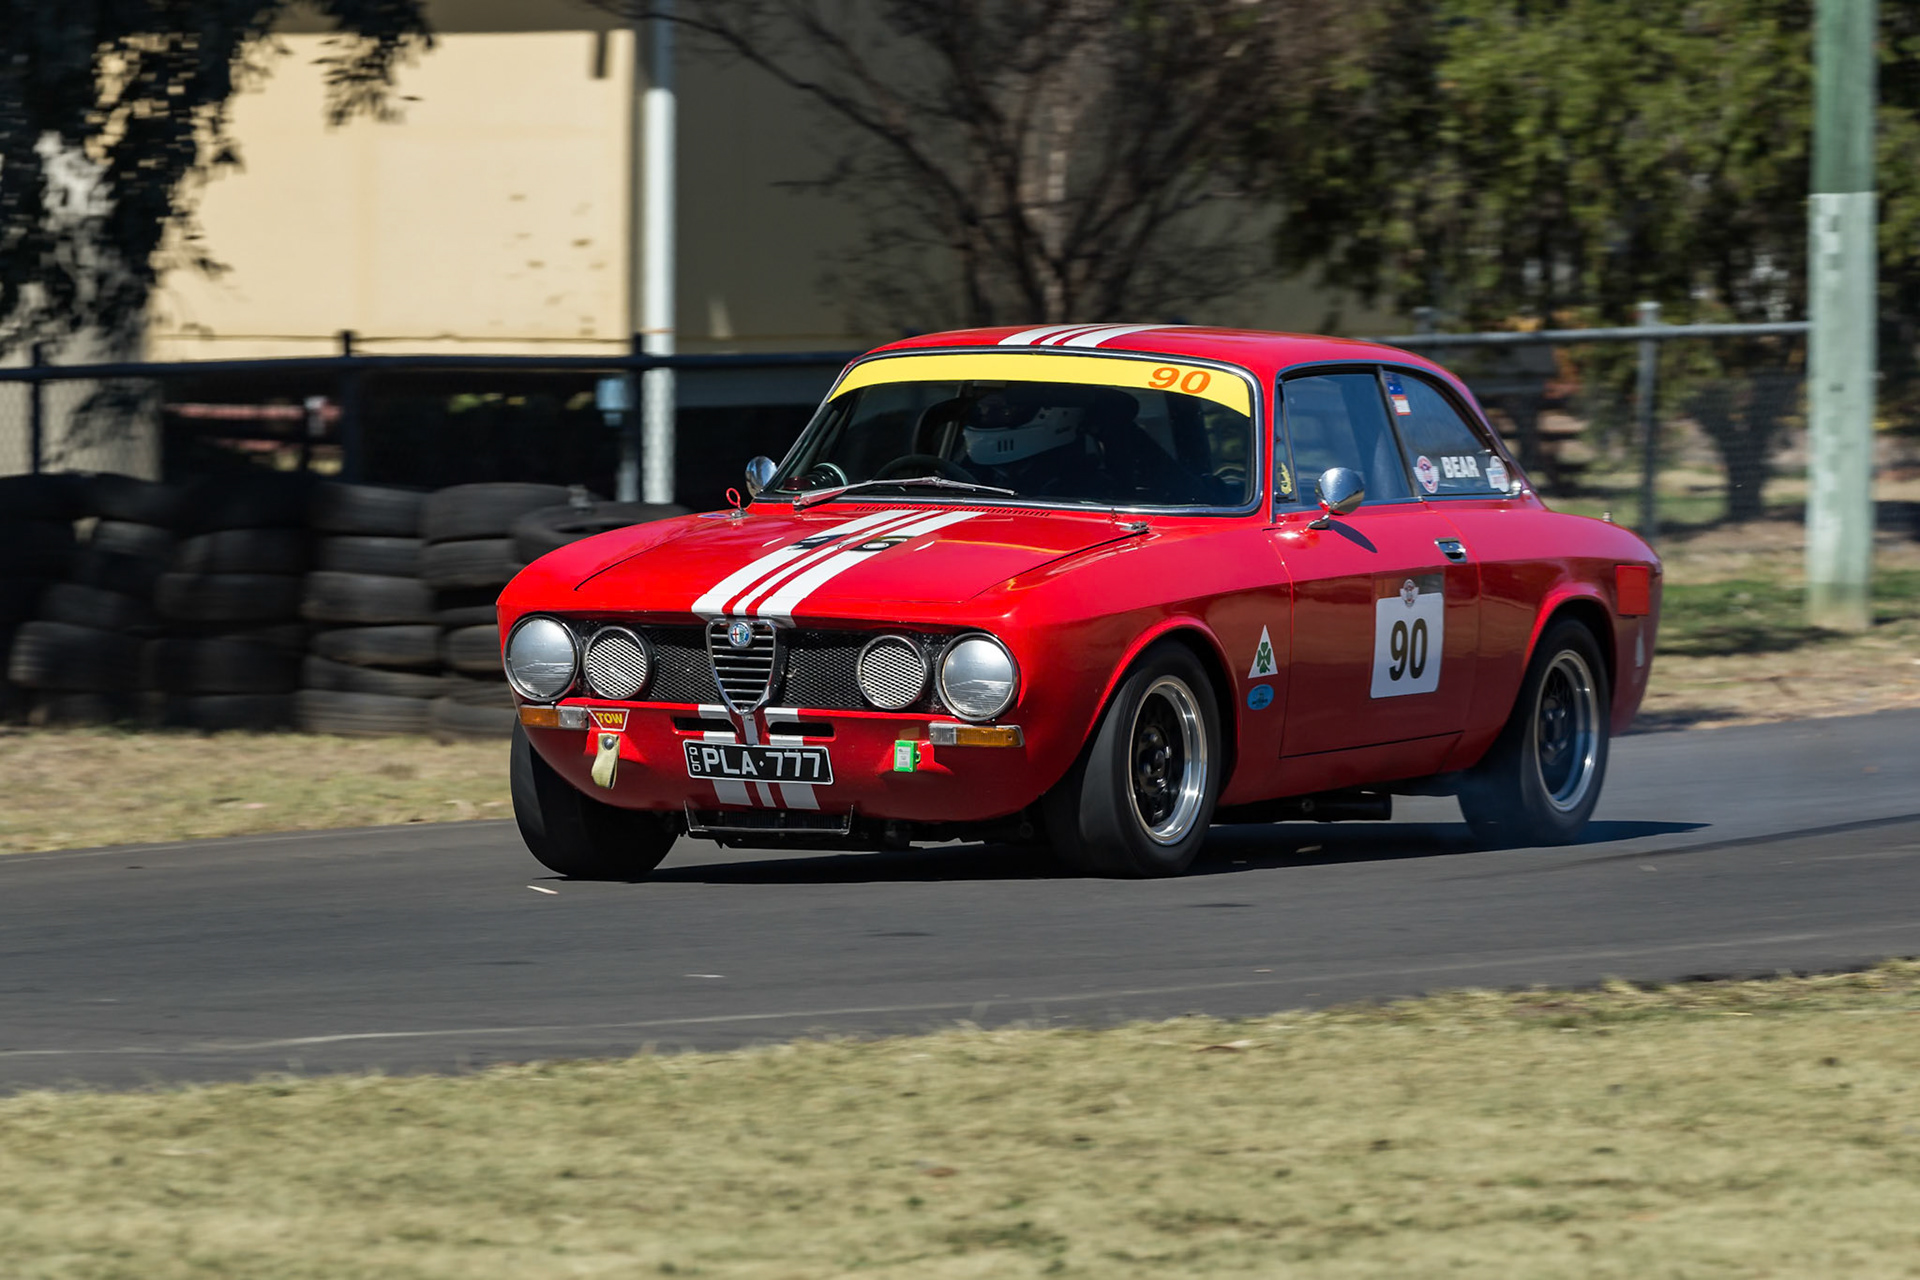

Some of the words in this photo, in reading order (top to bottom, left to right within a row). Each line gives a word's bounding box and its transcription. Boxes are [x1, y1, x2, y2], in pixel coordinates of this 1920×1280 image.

[1148, 367, 1211, 394] 90
[1441, 456, 1480, 478] BEAR
[1389, 618, 1428, 681] 90
[596, 712, 623, 724] TOW
[688, 746, 702, 772] QLD
